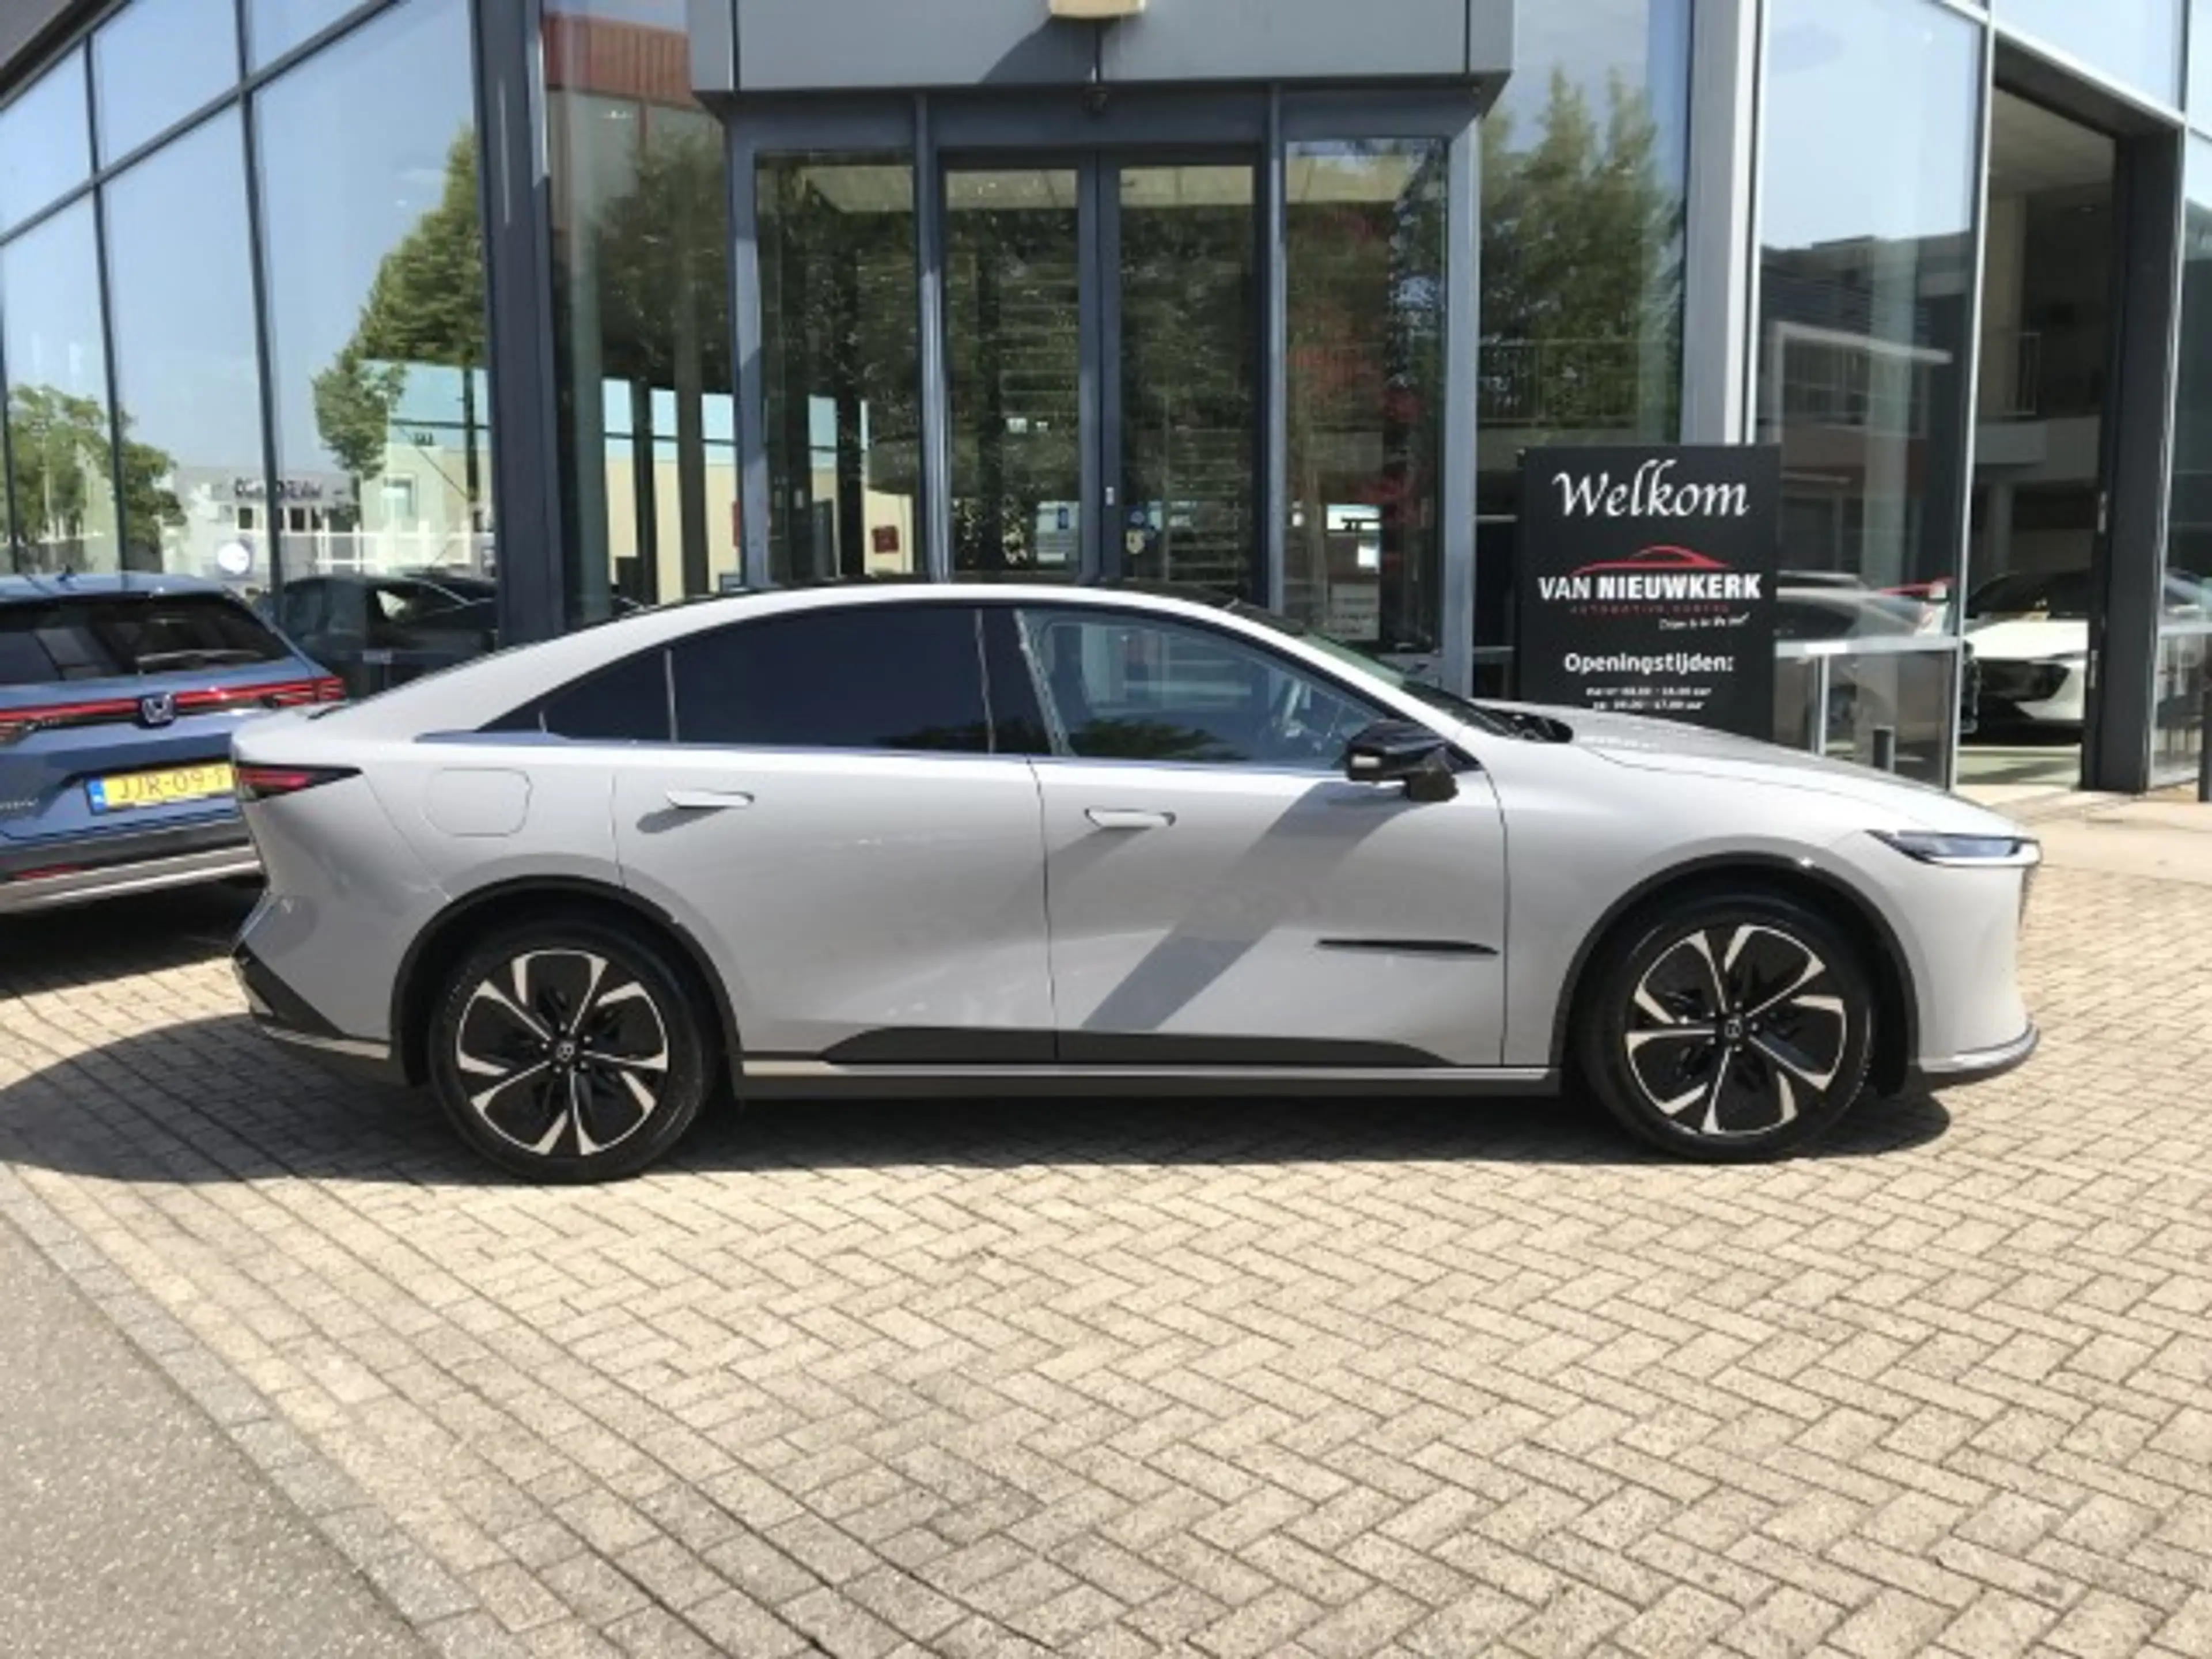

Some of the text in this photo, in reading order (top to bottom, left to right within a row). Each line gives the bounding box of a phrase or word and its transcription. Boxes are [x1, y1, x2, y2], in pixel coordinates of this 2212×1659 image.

[1552, 459, 1749, 516] Welkom
[1539, 574, 1762, 600] VAN NIEUWKERK
[1564, 653, 1734, 675] Openingstijden:
